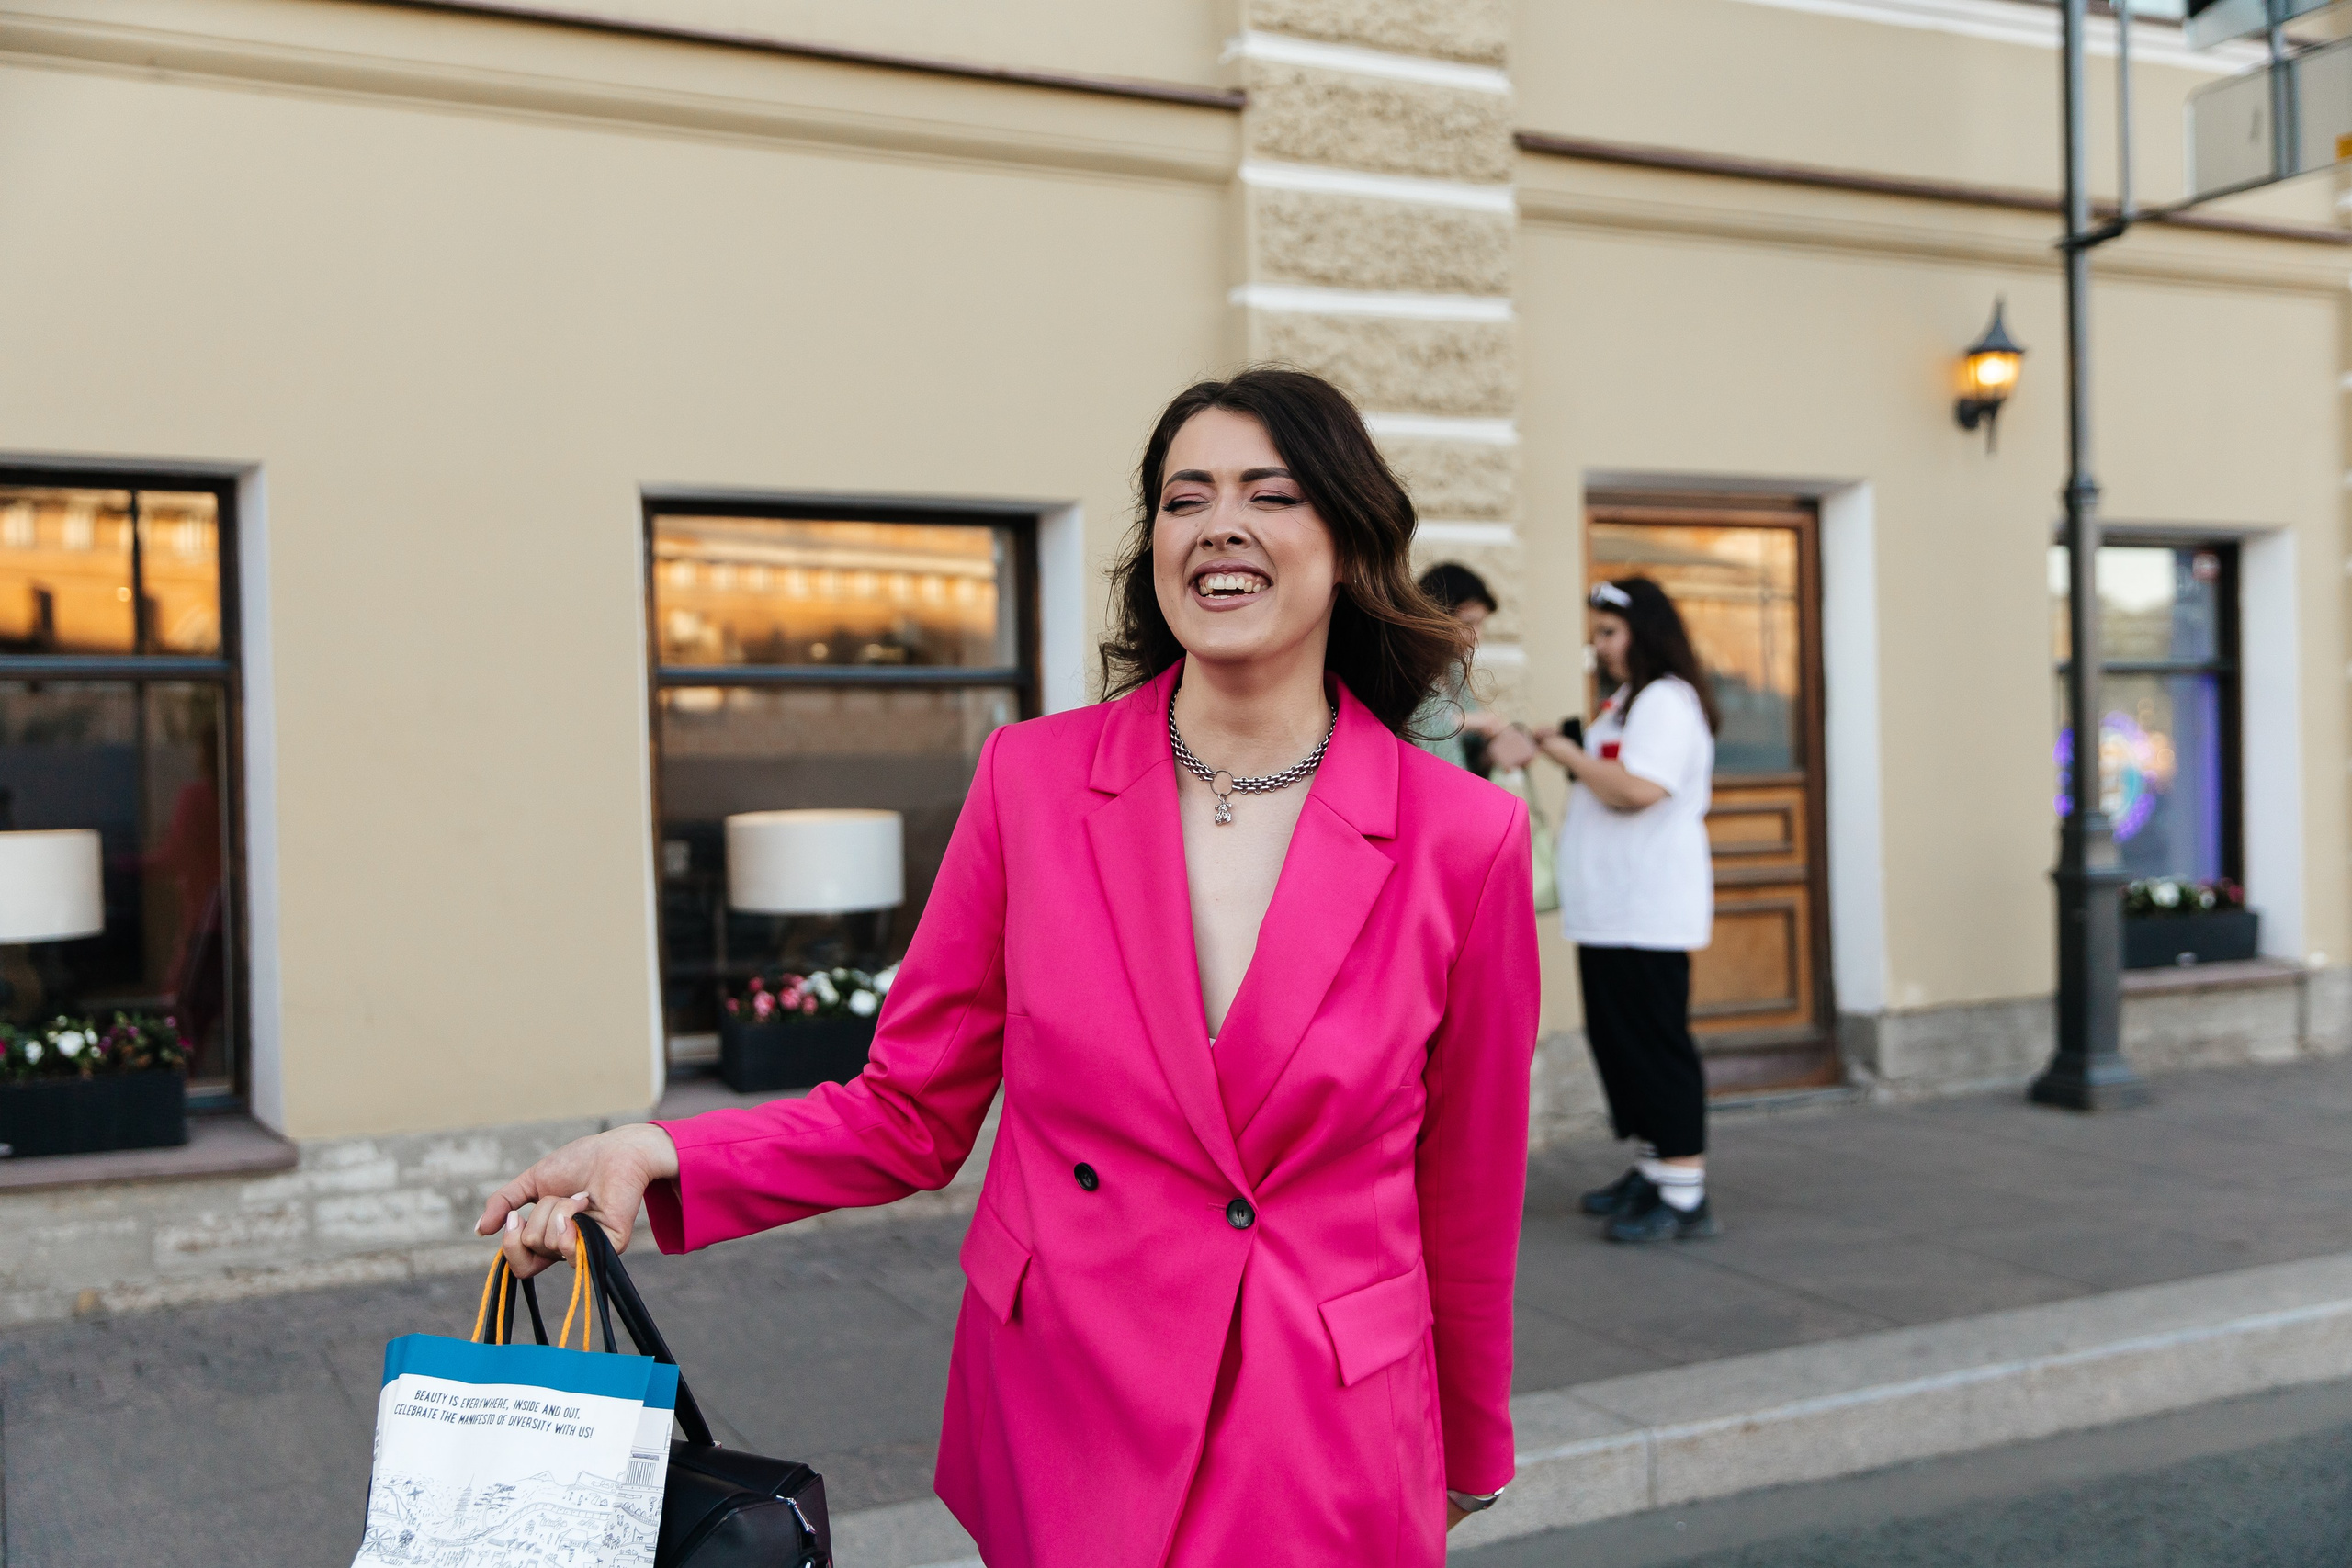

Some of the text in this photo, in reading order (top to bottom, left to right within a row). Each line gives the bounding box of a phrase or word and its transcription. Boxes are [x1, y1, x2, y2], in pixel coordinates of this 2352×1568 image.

[414, 1390, 580, 1419] BEAUTY IS EVERYWHERE, INSIDE AND OUT.
[394, 1404, 594, 1438] CELEBRATE THE MANIFESTO OF DIVERSITY WITH US!
